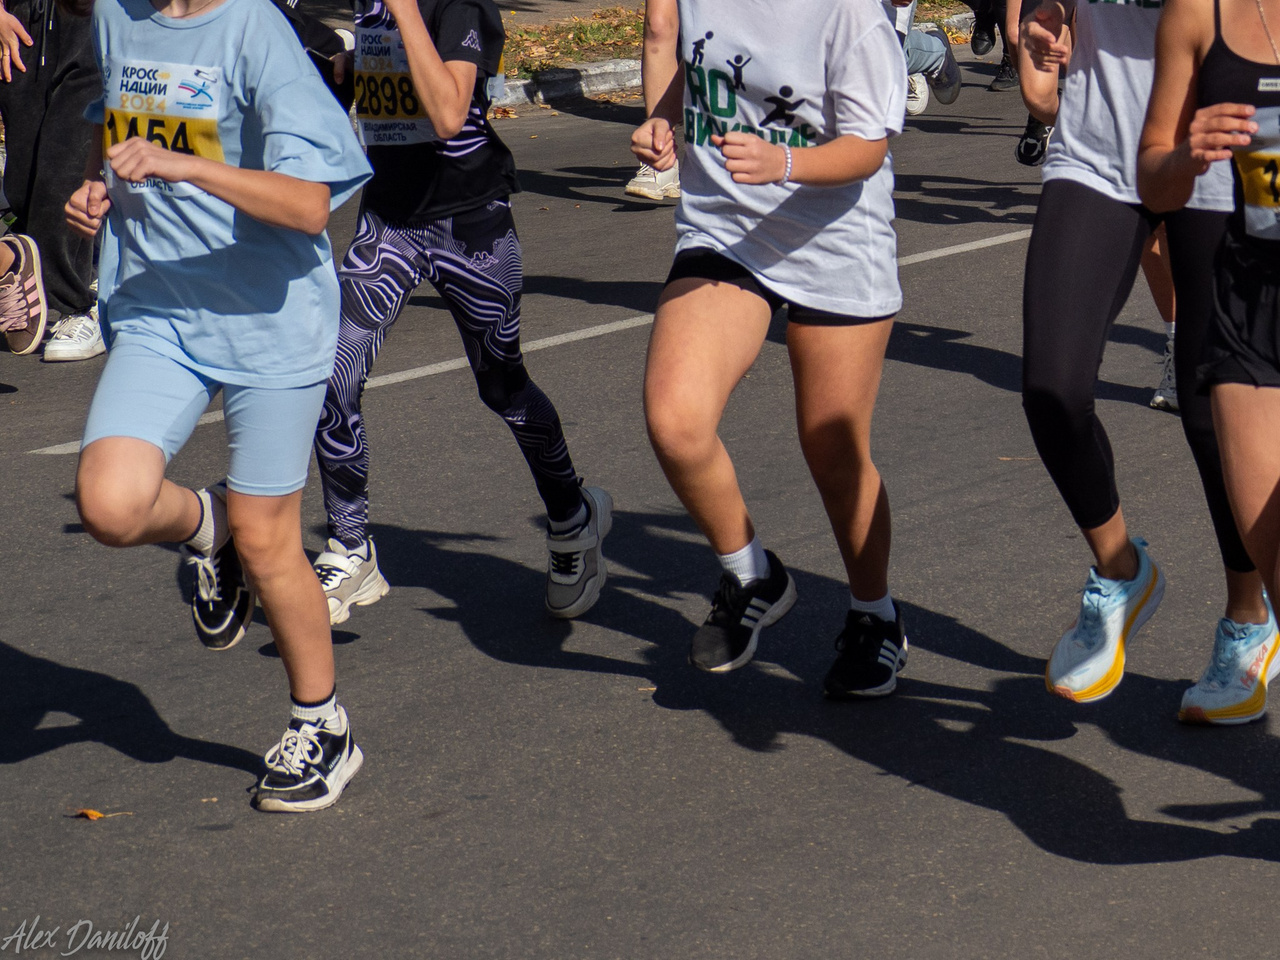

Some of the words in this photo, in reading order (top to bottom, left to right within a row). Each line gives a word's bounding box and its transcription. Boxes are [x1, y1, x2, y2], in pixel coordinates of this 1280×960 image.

[361, 34, 383, 45] КРОСС
[361, 45, 391, 57] НАЦИИ
[121, 66, 158, 81] КРОСС
[120, 79, 168, 96] НАЦИИ
[355, 74, 419, 116] 2898
[120, 93, 167, 113] 2024
[363, 122, 417, 132] ВЛАДИМИРСКАЯ
[373, 132, 407, 142] ОБЛАСТЬ
[1240, 643, 1268, 689] HOKA
